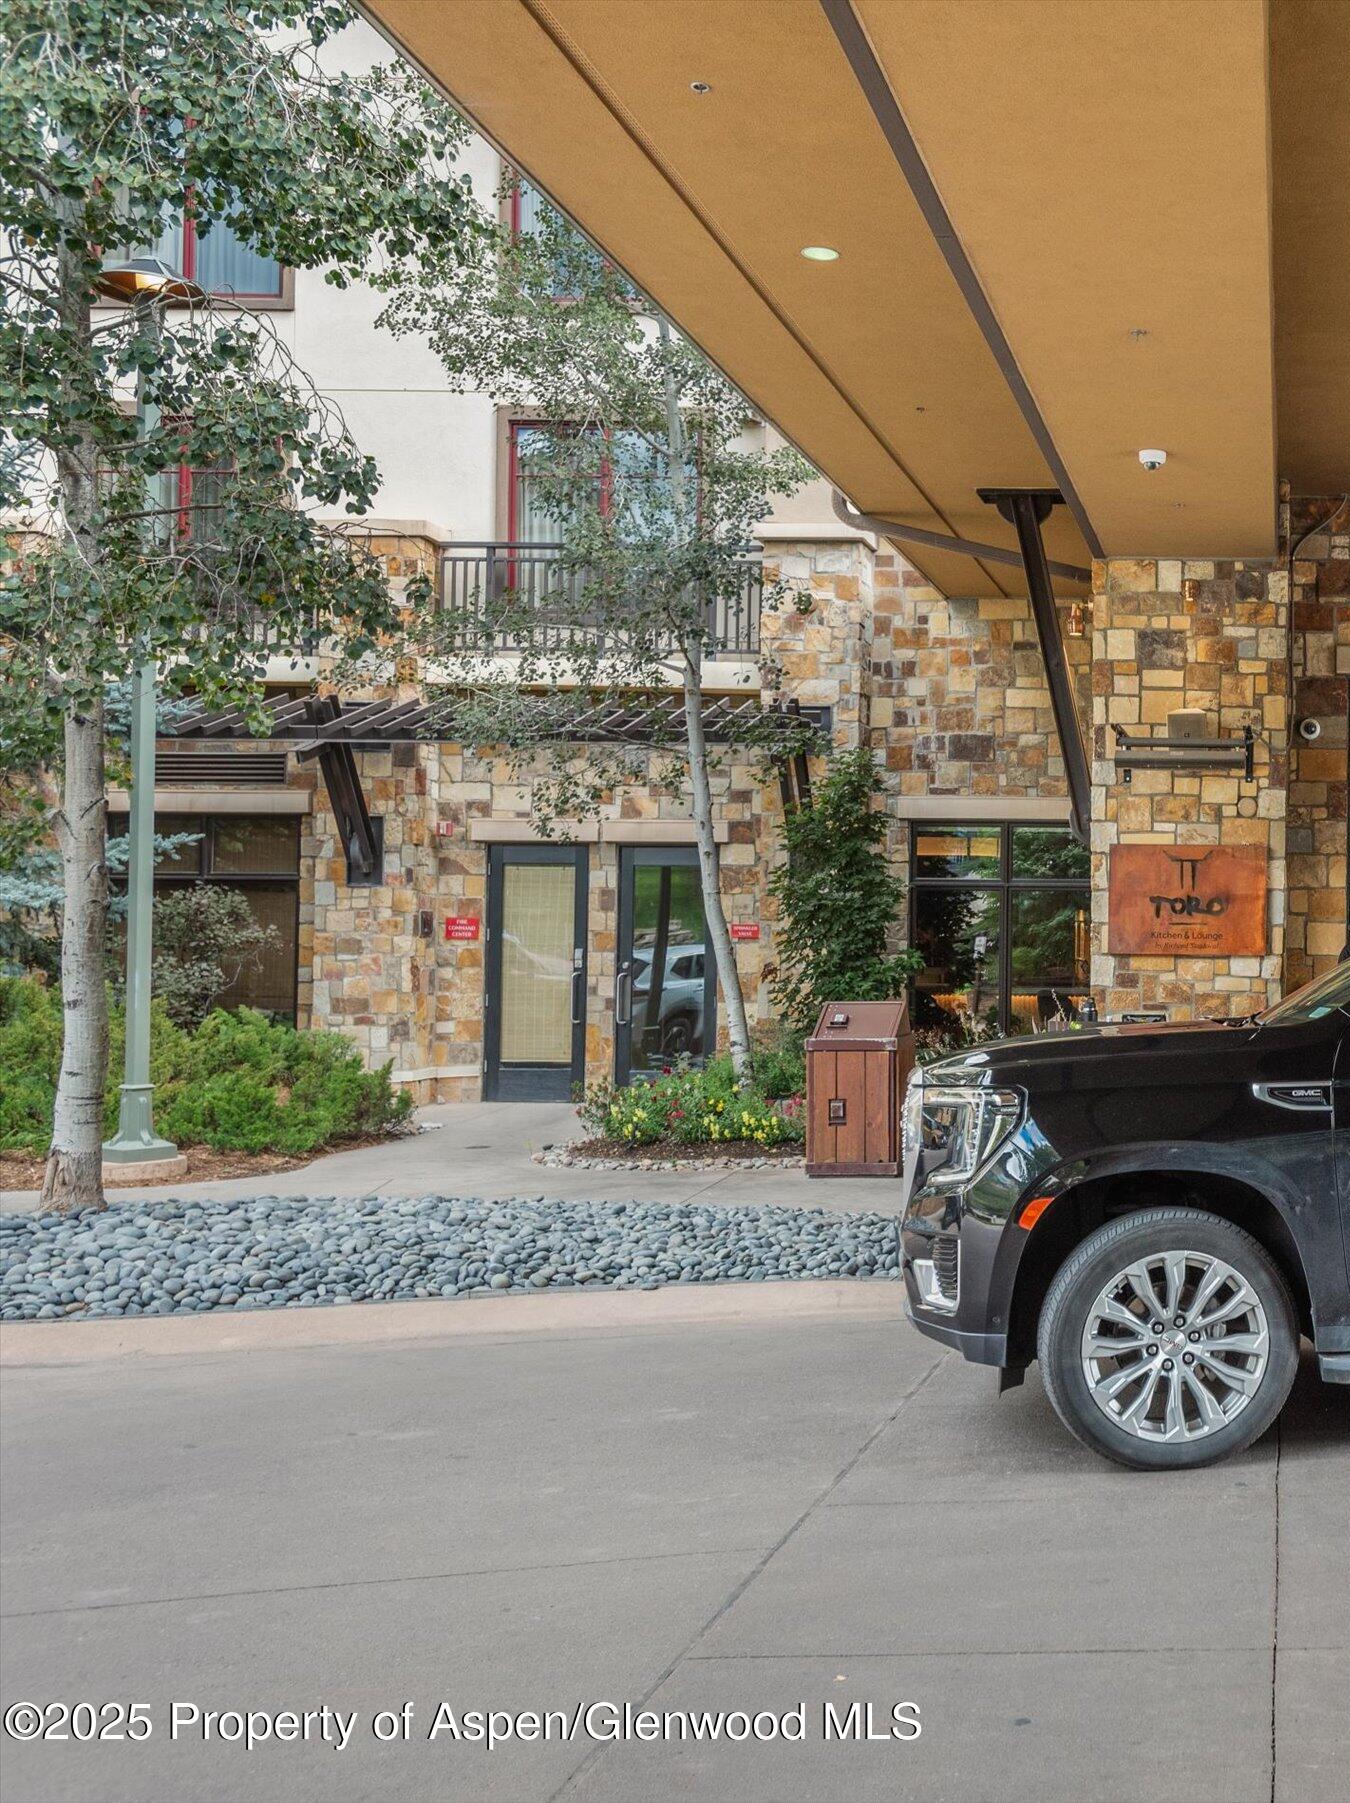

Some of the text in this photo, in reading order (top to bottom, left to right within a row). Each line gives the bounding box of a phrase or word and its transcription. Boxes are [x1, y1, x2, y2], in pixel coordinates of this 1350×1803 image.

[1149, 894, 1230, 918] TORO
[1150, 931, 1224, 941] Kitchen & Lounge
[1291, 1089, 1321, 1097] GMC
